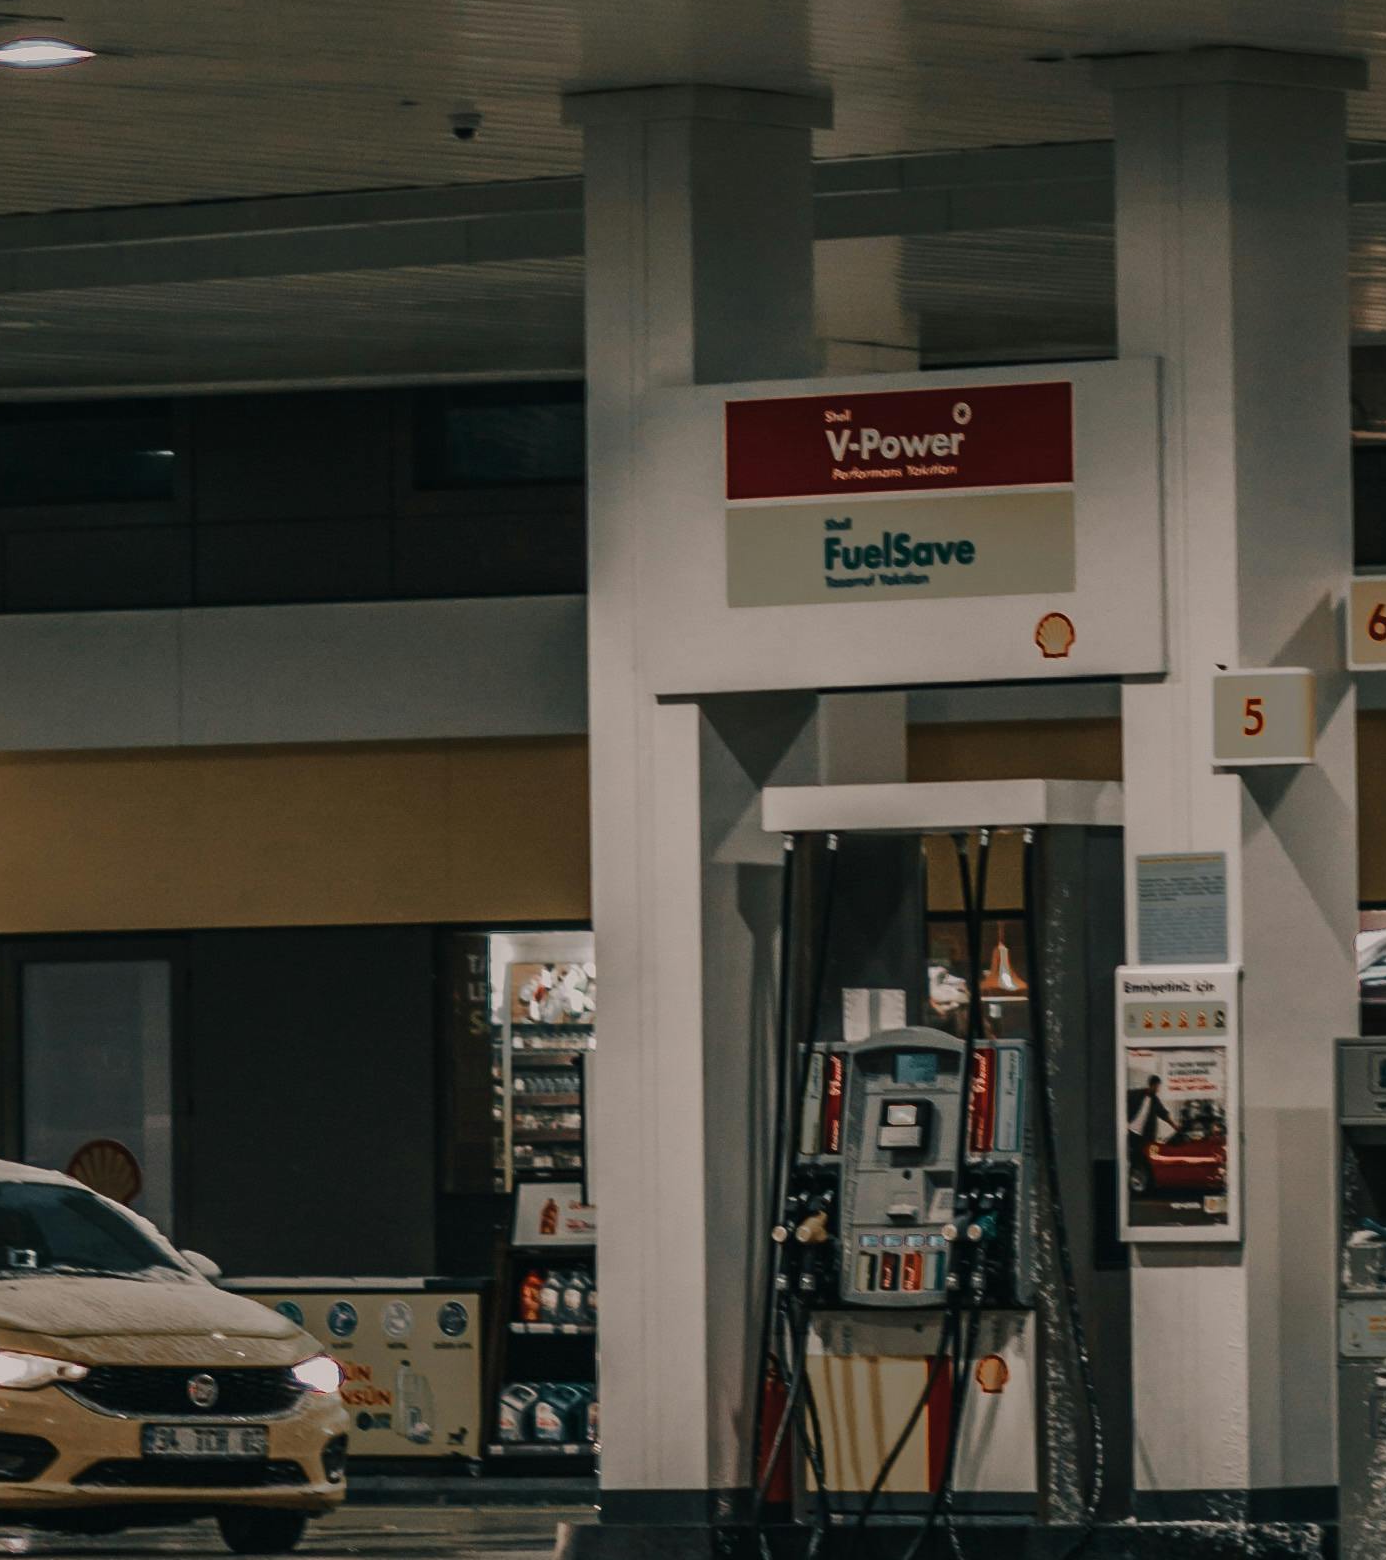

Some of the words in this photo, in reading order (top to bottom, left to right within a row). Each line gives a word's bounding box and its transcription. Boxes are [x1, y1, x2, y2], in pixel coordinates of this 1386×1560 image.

[823, 409, 853, 423] Shell
[824, 427, 966, 462] V-Power
[831, 466, 903, 480] Performans
[824, 531, 976, 570] FuelSave
[1244, 698, 1264, 736] 5
